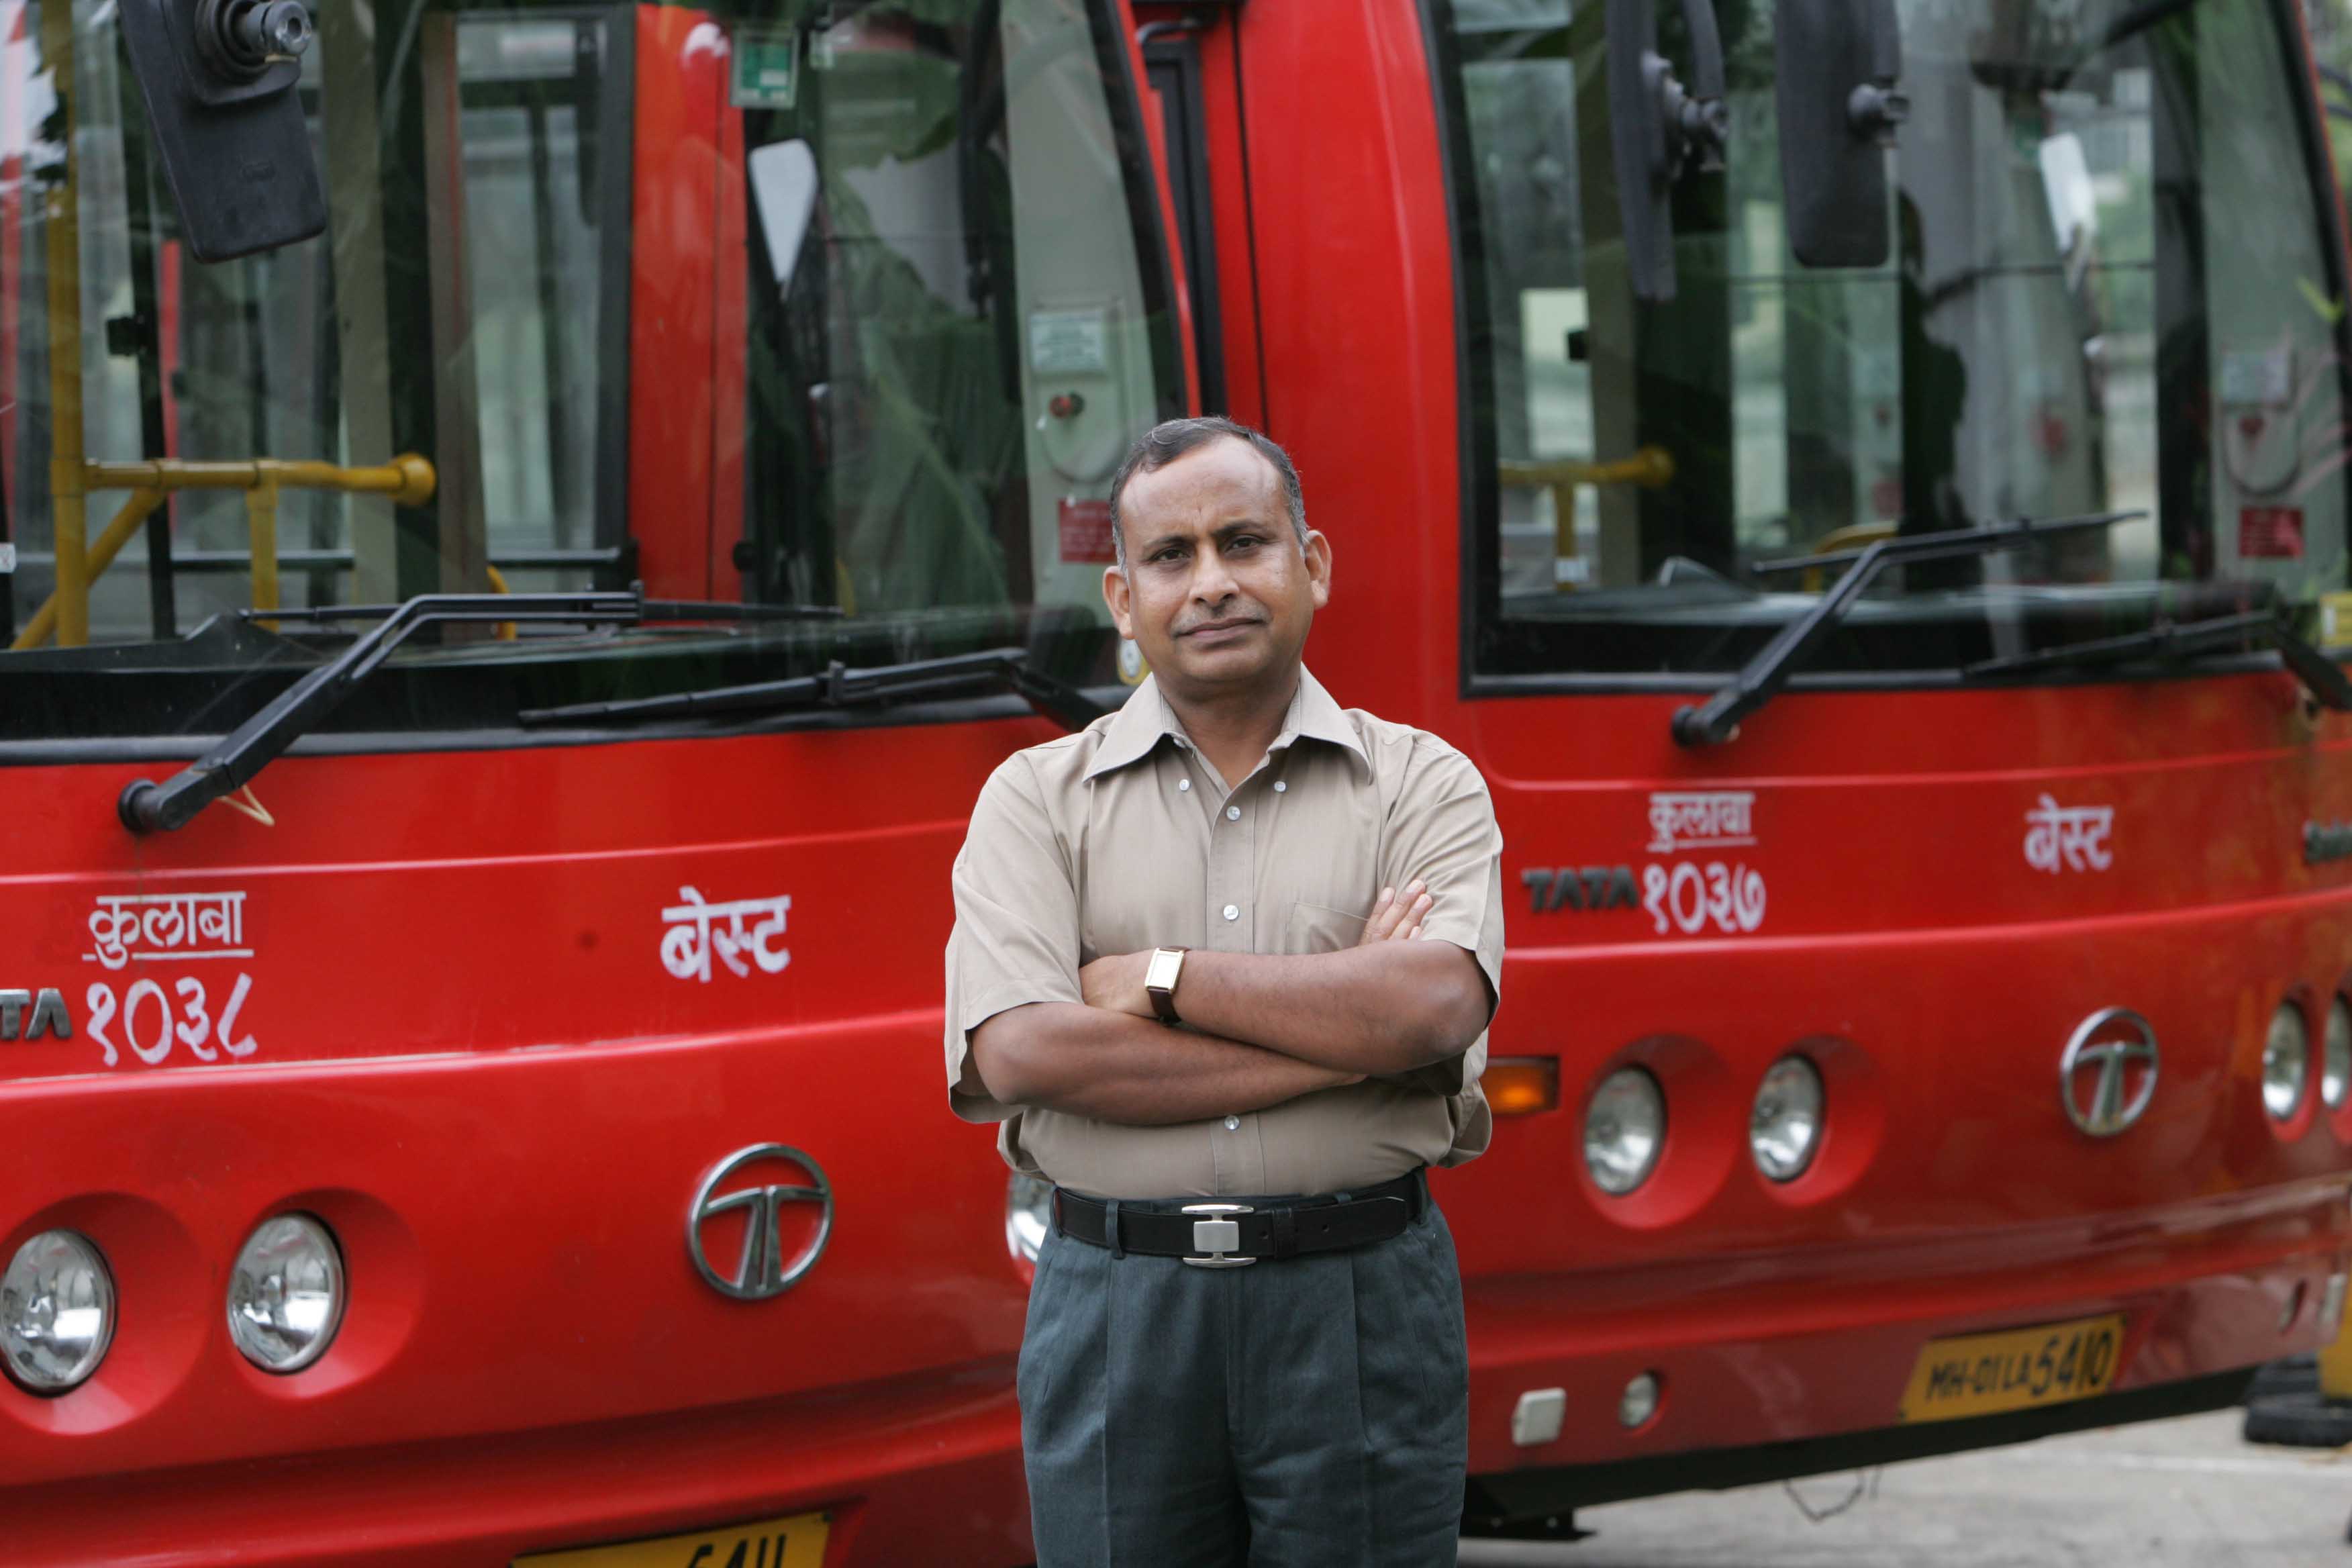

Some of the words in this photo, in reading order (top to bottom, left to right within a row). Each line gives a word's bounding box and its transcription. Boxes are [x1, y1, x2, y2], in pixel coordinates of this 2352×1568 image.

[1648, 791, 1755, 853] कुलाबा
[2024, 792, 2114, 874] बेस्ट
[1521, 864, 1638, 912] TATA
[1643, 862, 1766, 934] १०३७
[88, 891, 246, 969] कुलाबा
[660, 885, 792, 983] बेस्ट
[87, 972, 257, 1066] १०३८
